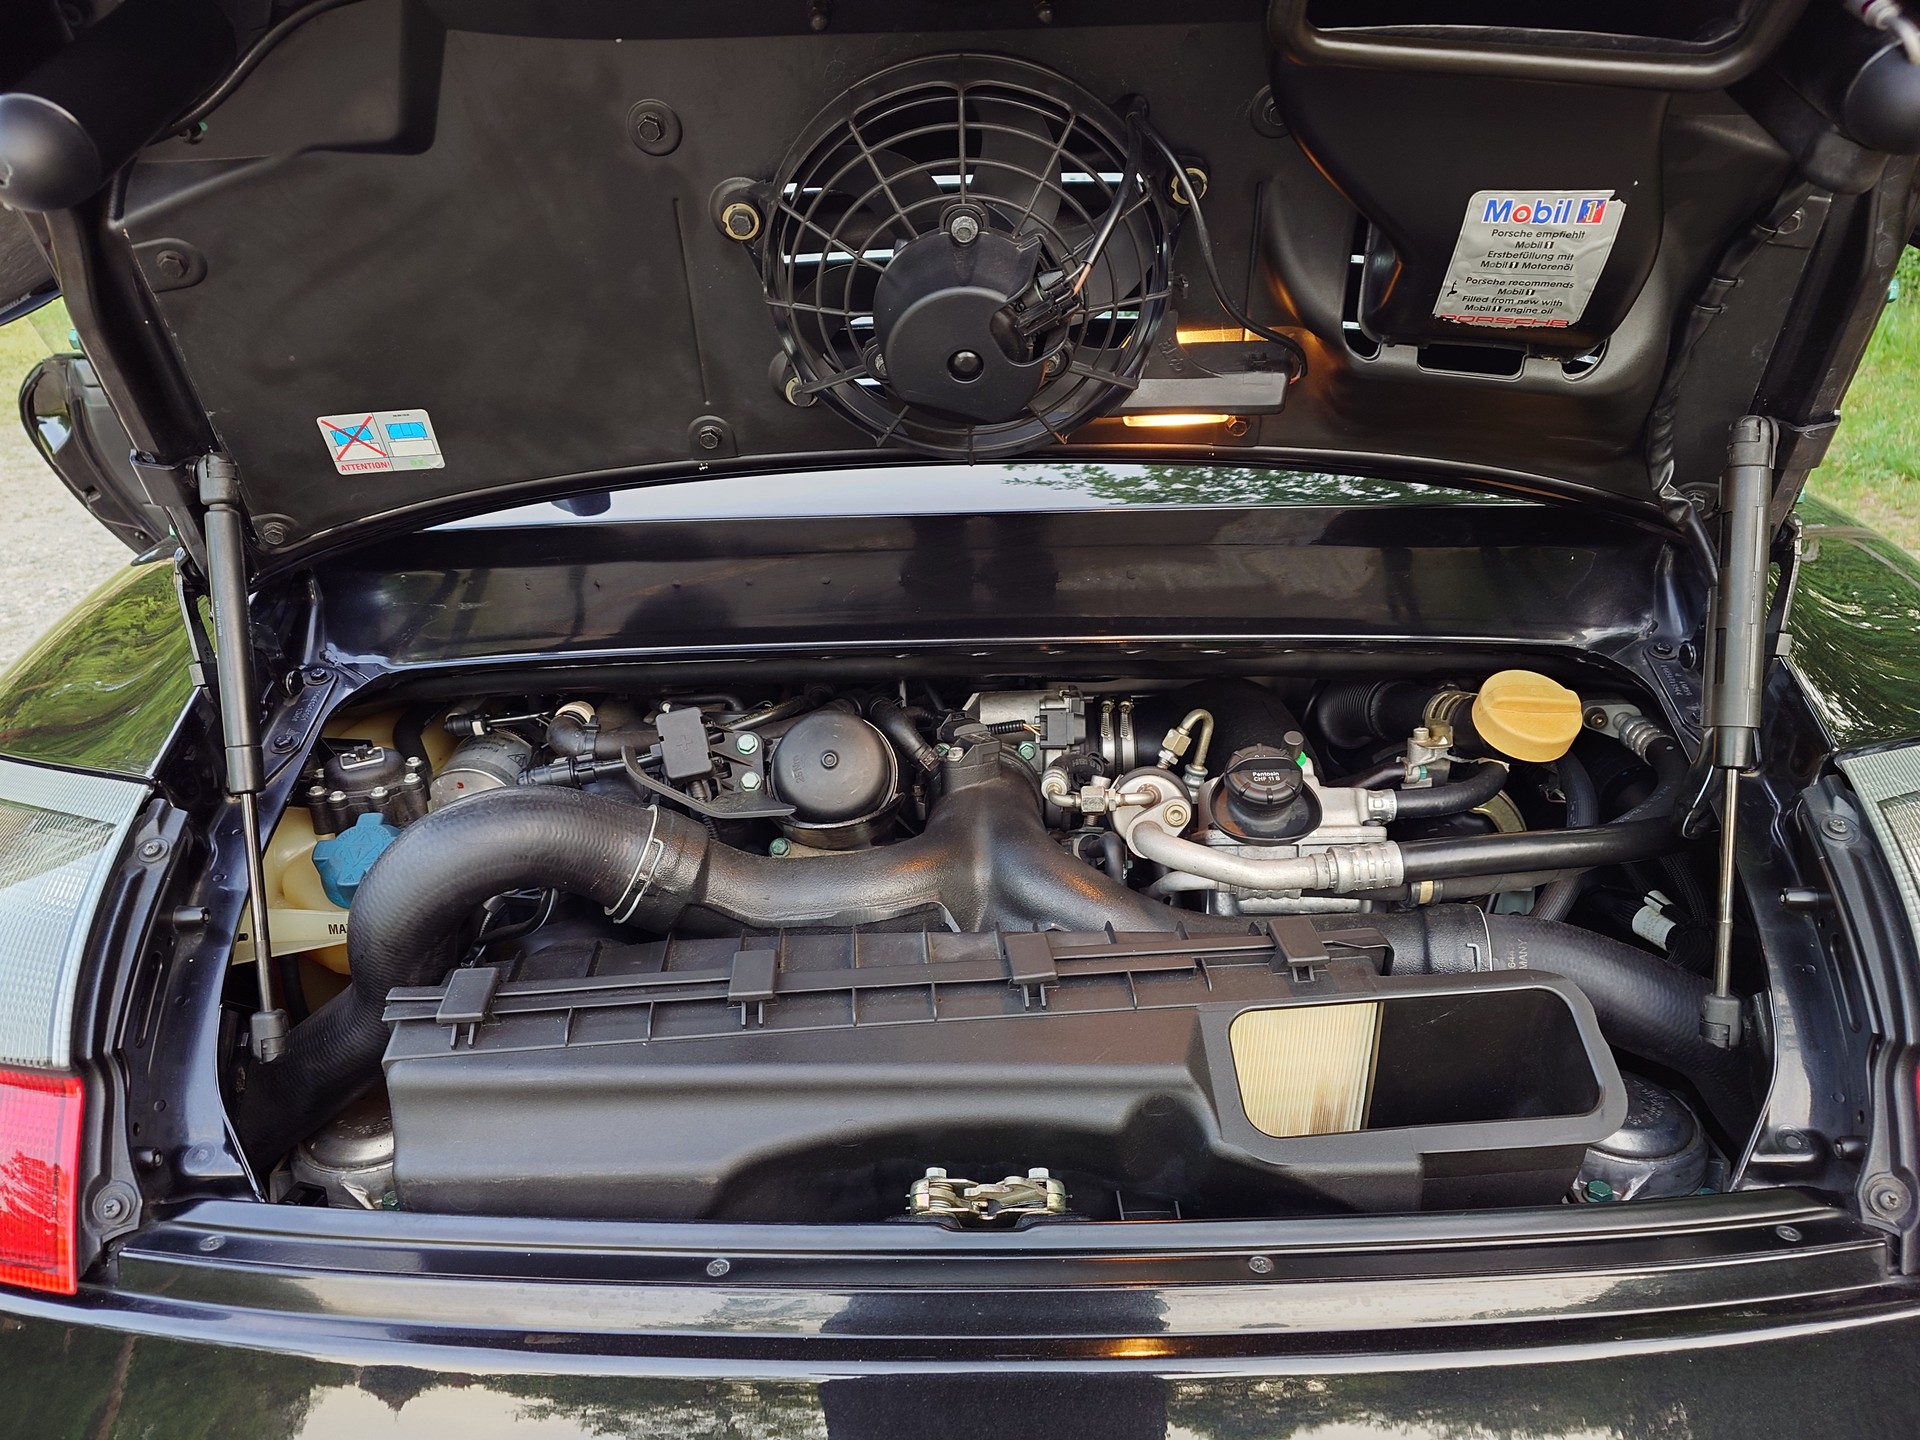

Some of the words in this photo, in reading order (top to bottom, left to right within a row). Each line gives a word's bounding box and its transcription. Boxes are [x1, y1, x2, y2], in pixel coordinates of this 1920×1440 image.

[1483, 199, 1573, 224] Mobil
[1491, 229, 1533, 238] Porsche
[1536, 230, 1586, 239] empfiehlt
[1515, 241, 1542, 249] Mobil
[1487, 251, 1554, 261] Erstbefüllung
[1557, 253, 1574, 261] mit
[1480, 260, 1508, 269] Mobil
[1521, 262, 1573, 271] Motorenöl
[1465, 277, 1505, 286] Porsche
[1508, 279, 1574, 289] recommends
[1497, 288, 1525, 296] Mobil
[1462, 295, 1489, 304] Filled
[1541, 299, 1563, 307] with
[1464, 304, 1491, 312] Mobil
[1504, 307, 1538, 315] engine
[1540, 307, 1554, 315] oil
[340, 461, 390, 472] ATTENTION!
